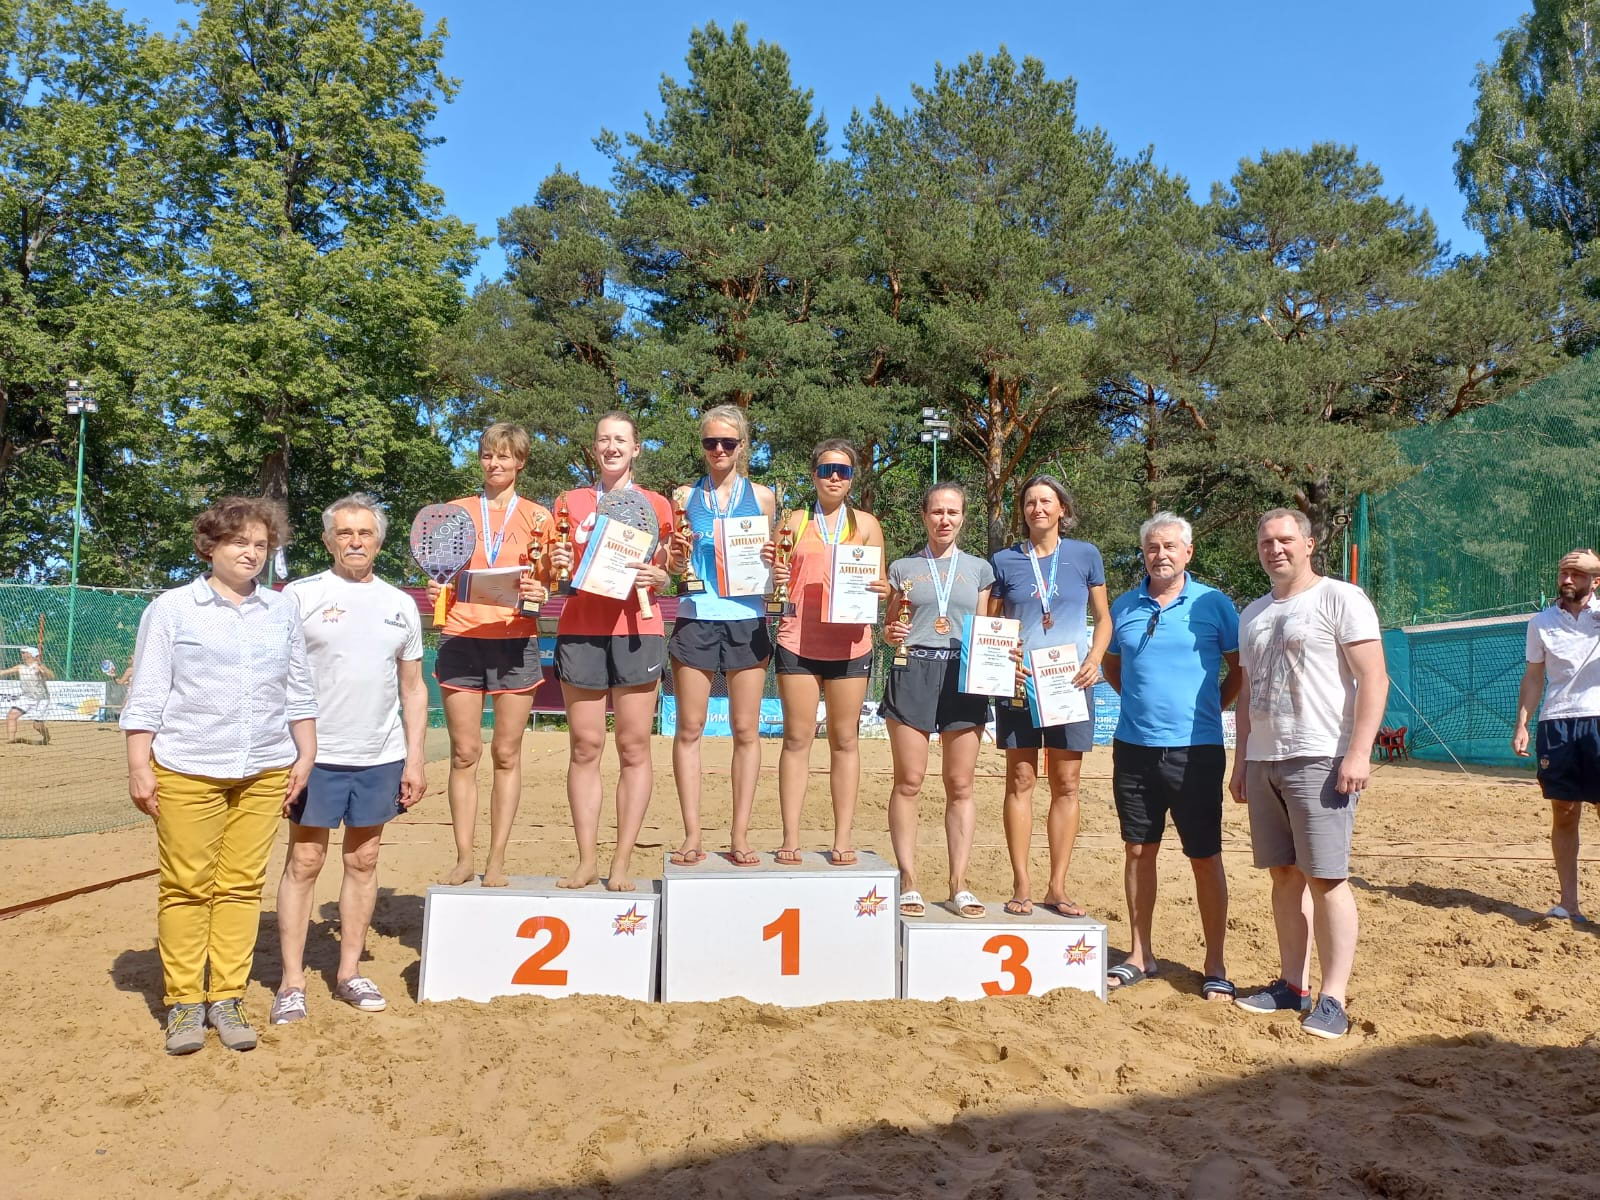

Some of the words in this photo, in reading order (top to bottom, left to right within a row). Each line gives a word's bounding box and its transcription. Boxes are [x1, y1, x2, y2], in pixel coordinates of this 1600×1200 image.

[730, 536, 765, 547] ДИПЛОМ
[604, 541, 641, 559] ДИПЛОМ
[839, 565, 876, 575] ДИПЛОМ
[976, 637, 1014, 648] ДИПЛОМ
[1040, 664, 1076, 678] ДИПЛОМ
[763, 908, 800, 976] 1
[511, 916, 570, 986] 2
[981, 934, 1032, 997] 3
